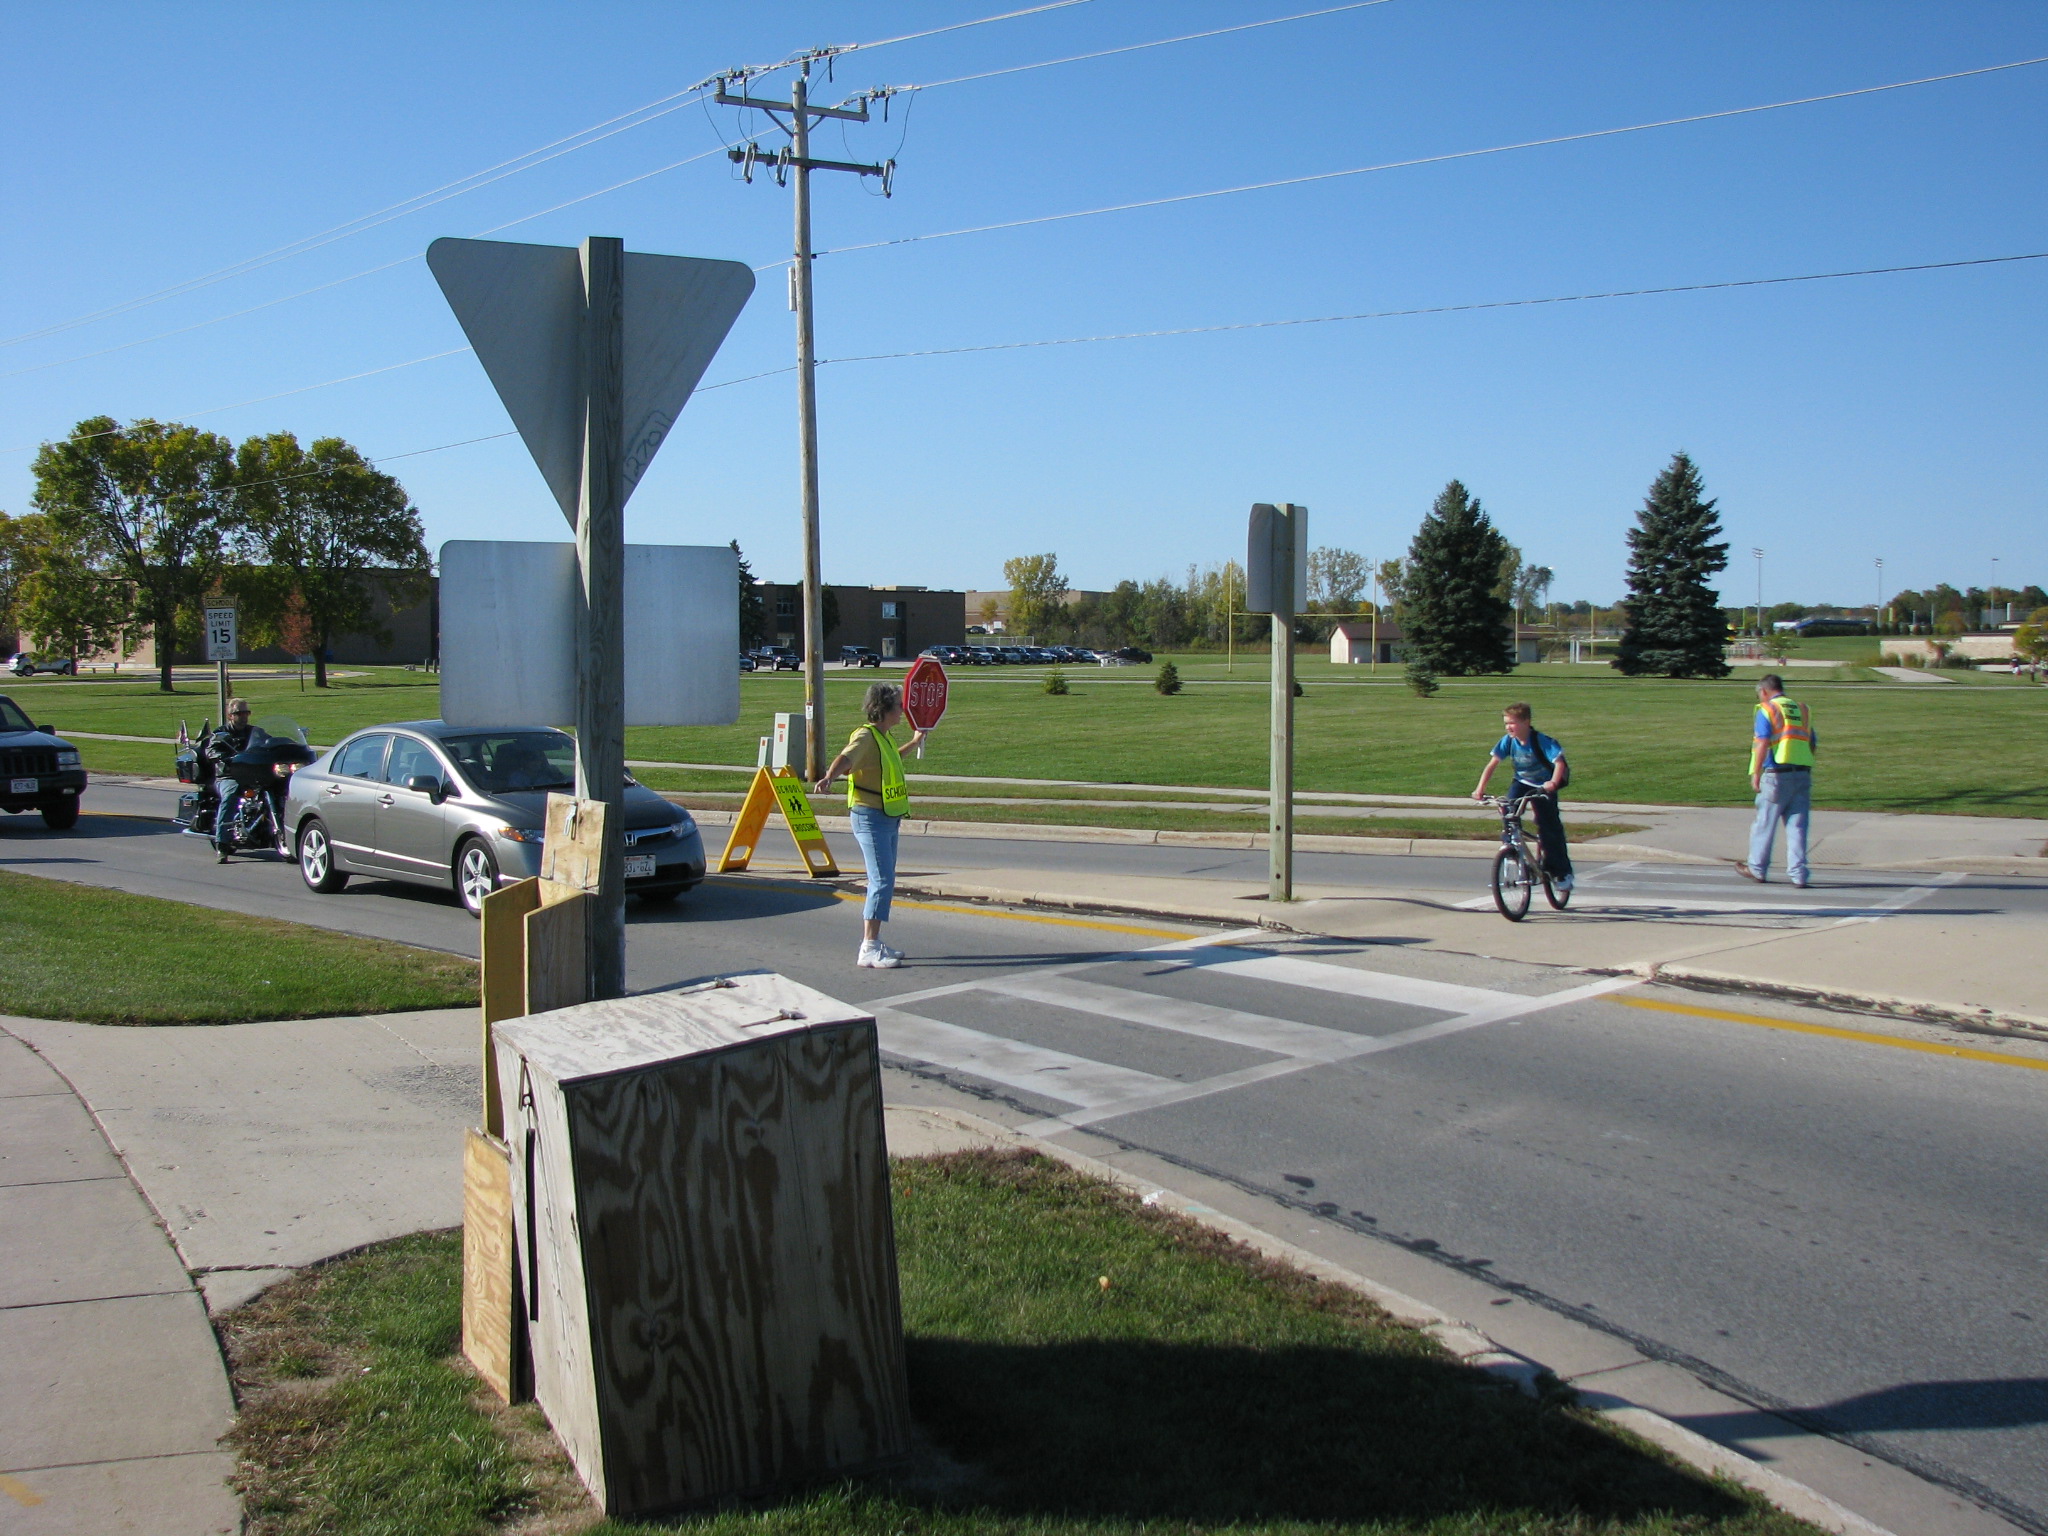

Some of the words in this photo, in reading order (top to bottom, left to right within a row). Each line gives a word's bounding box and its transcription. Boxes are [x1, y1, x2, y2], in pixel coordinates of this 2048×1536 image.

[212, 628, 231, 644] 15
[910, 681, 945, 708] STOP
[776, 785, 802, 794] SCHOOL
[791, 823, 819, 833] CROSSING
